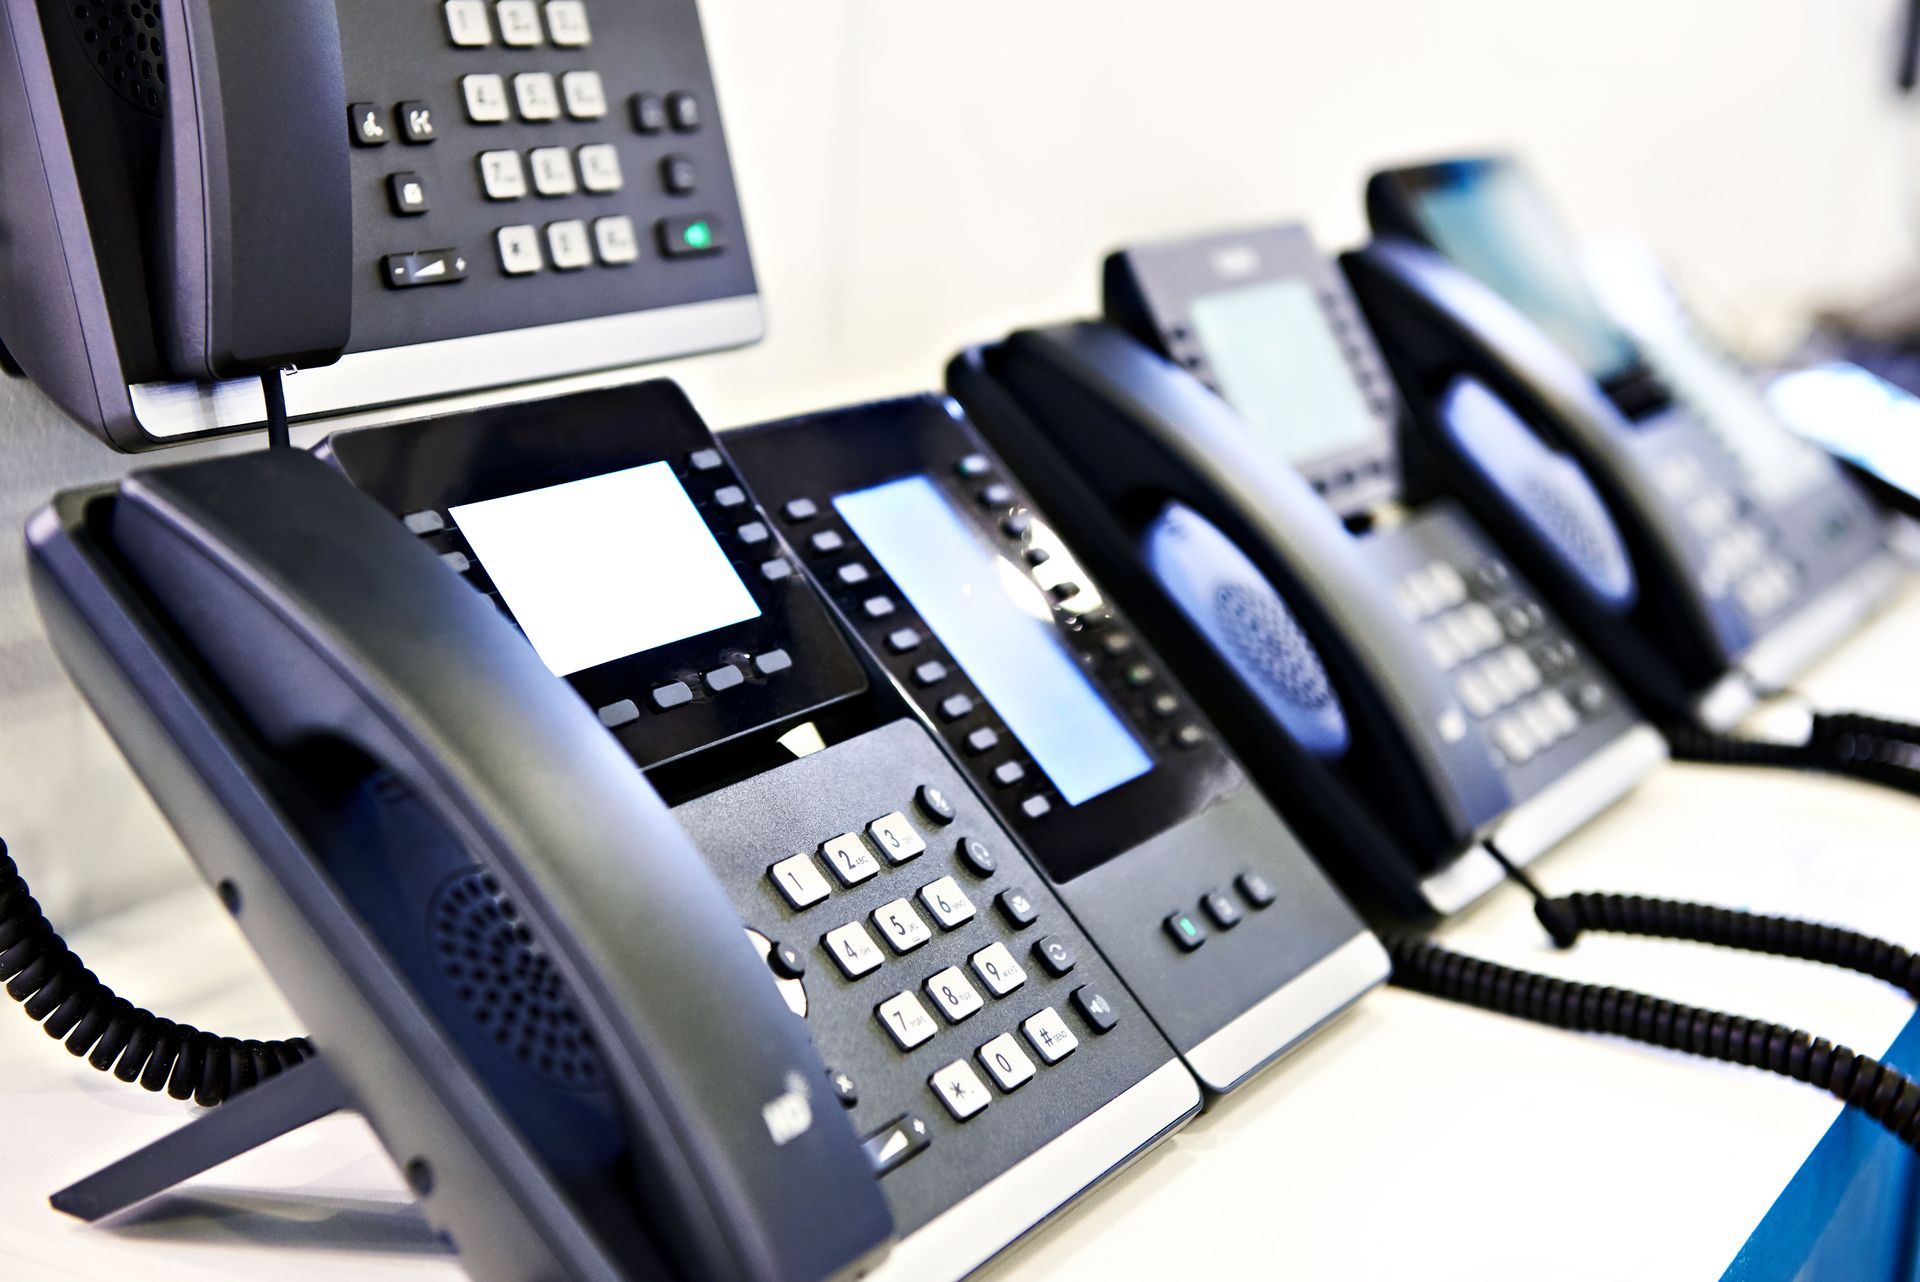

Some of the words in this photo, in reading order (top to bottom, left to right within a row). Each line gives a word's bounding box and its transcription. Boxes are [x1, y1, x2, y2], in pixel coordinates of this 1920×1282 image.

[884, 829, 900, 848] 3
[838, 849, 856, 870] 2
[855, 855, 869, 866] ABC
[788, 872, 804, 891] 1
[937, 895, 951, 913] 6
[889, 915, 906, 935] 5
[844, 939, 858, 959] 4
[985, 961, 1000, 981] 9
[942, 986, 959, 1006] 8
[959, 991, 971, 1001] TUV
[893, 1010, 907, 1032] 7
[1039, 1028, 1053, 1047] #
[1053, 1030, 1068, 1043] SEND
[996, 1053, 1012, 1072] 0
